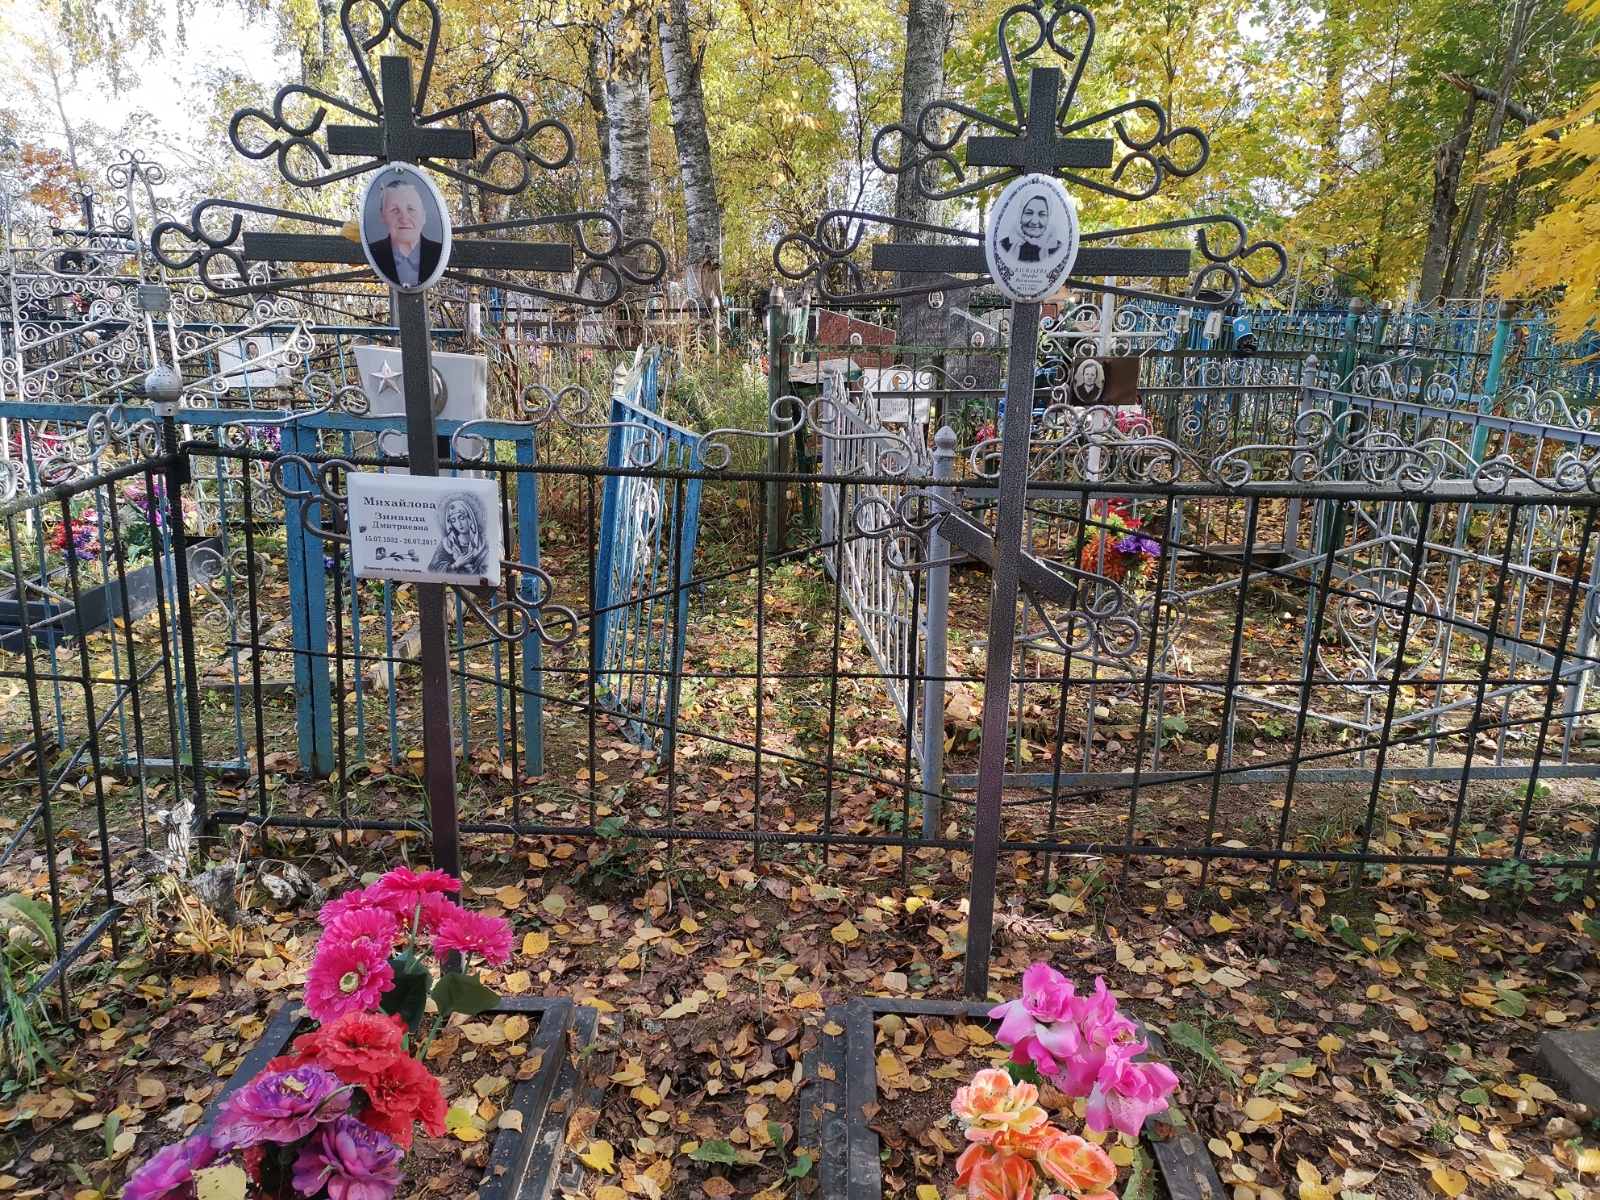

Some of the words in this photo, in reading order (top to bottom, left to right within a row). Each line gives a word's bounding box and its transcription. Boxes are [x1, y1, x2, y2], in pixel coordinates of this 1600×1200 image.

[363, 496, 437, 510] Михайлова
[374, 512, 425, 522] Зинаида
[372, 521, 429, 532] Дмитриевна
[365, 535, 399, 544] 15.07.1932
[403, 537, 437, 546] 26.07.2017
